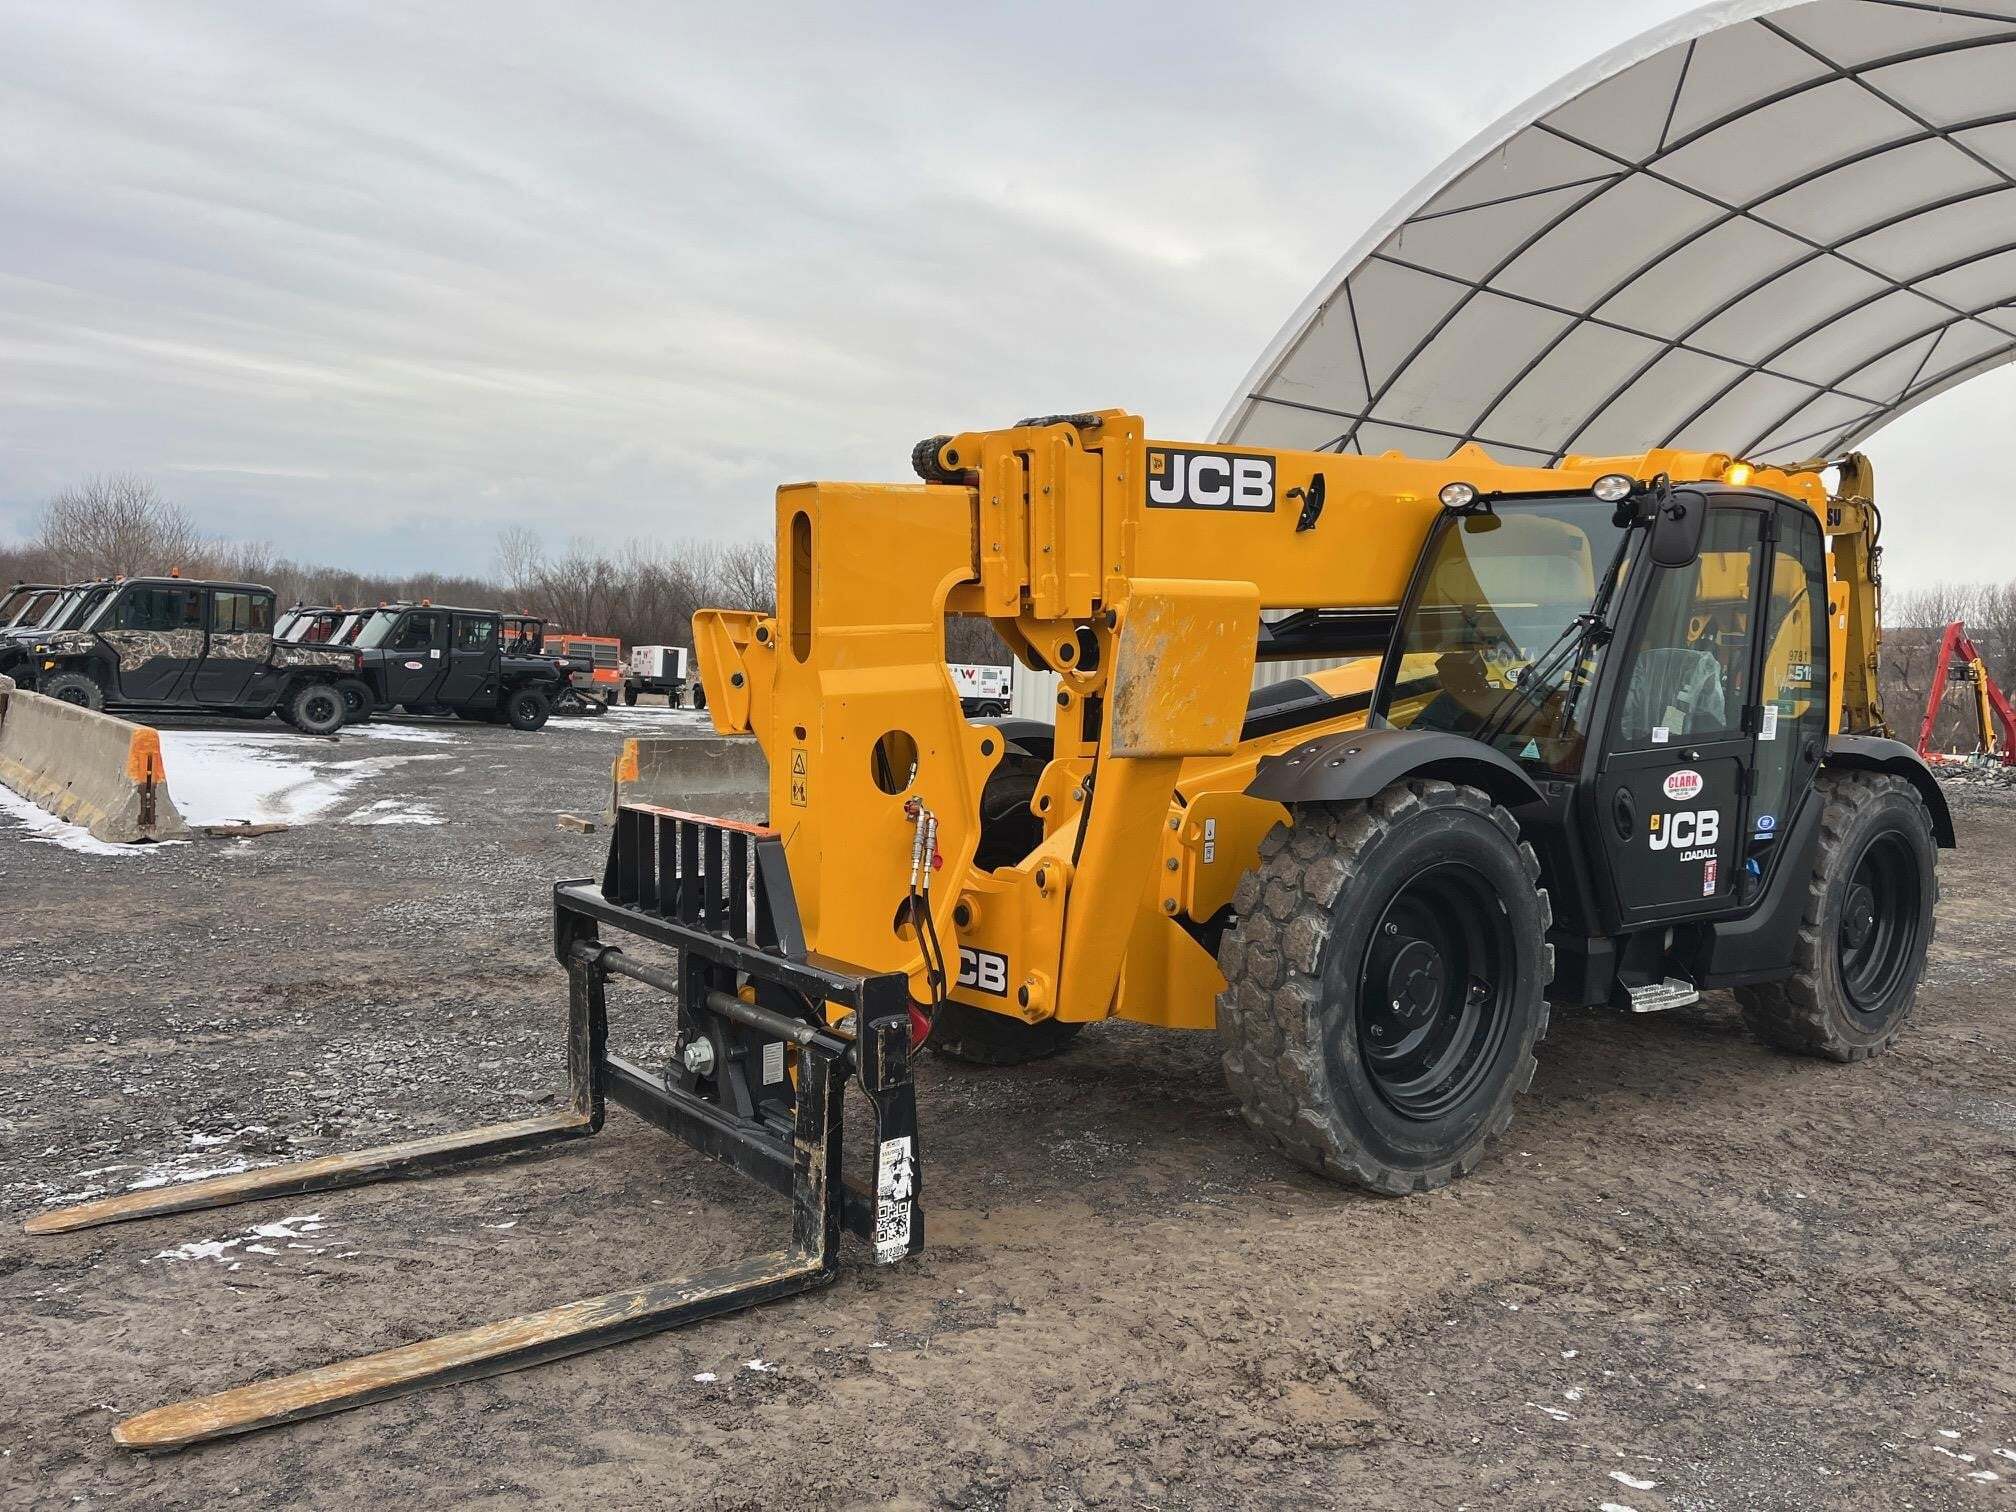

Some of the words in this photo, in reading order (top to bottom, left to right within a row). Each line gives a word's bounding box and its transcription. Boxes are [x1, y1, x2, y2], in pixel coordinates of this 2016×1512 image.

[1150, 454, 1273, 507] JCB
[1668, 775, 1697, 788] CLARK
[1649, 809, 1720, 851] JCB
[1680, 848, 1718, 862] LOADALL
[958, 948, 1006, 992] CB
